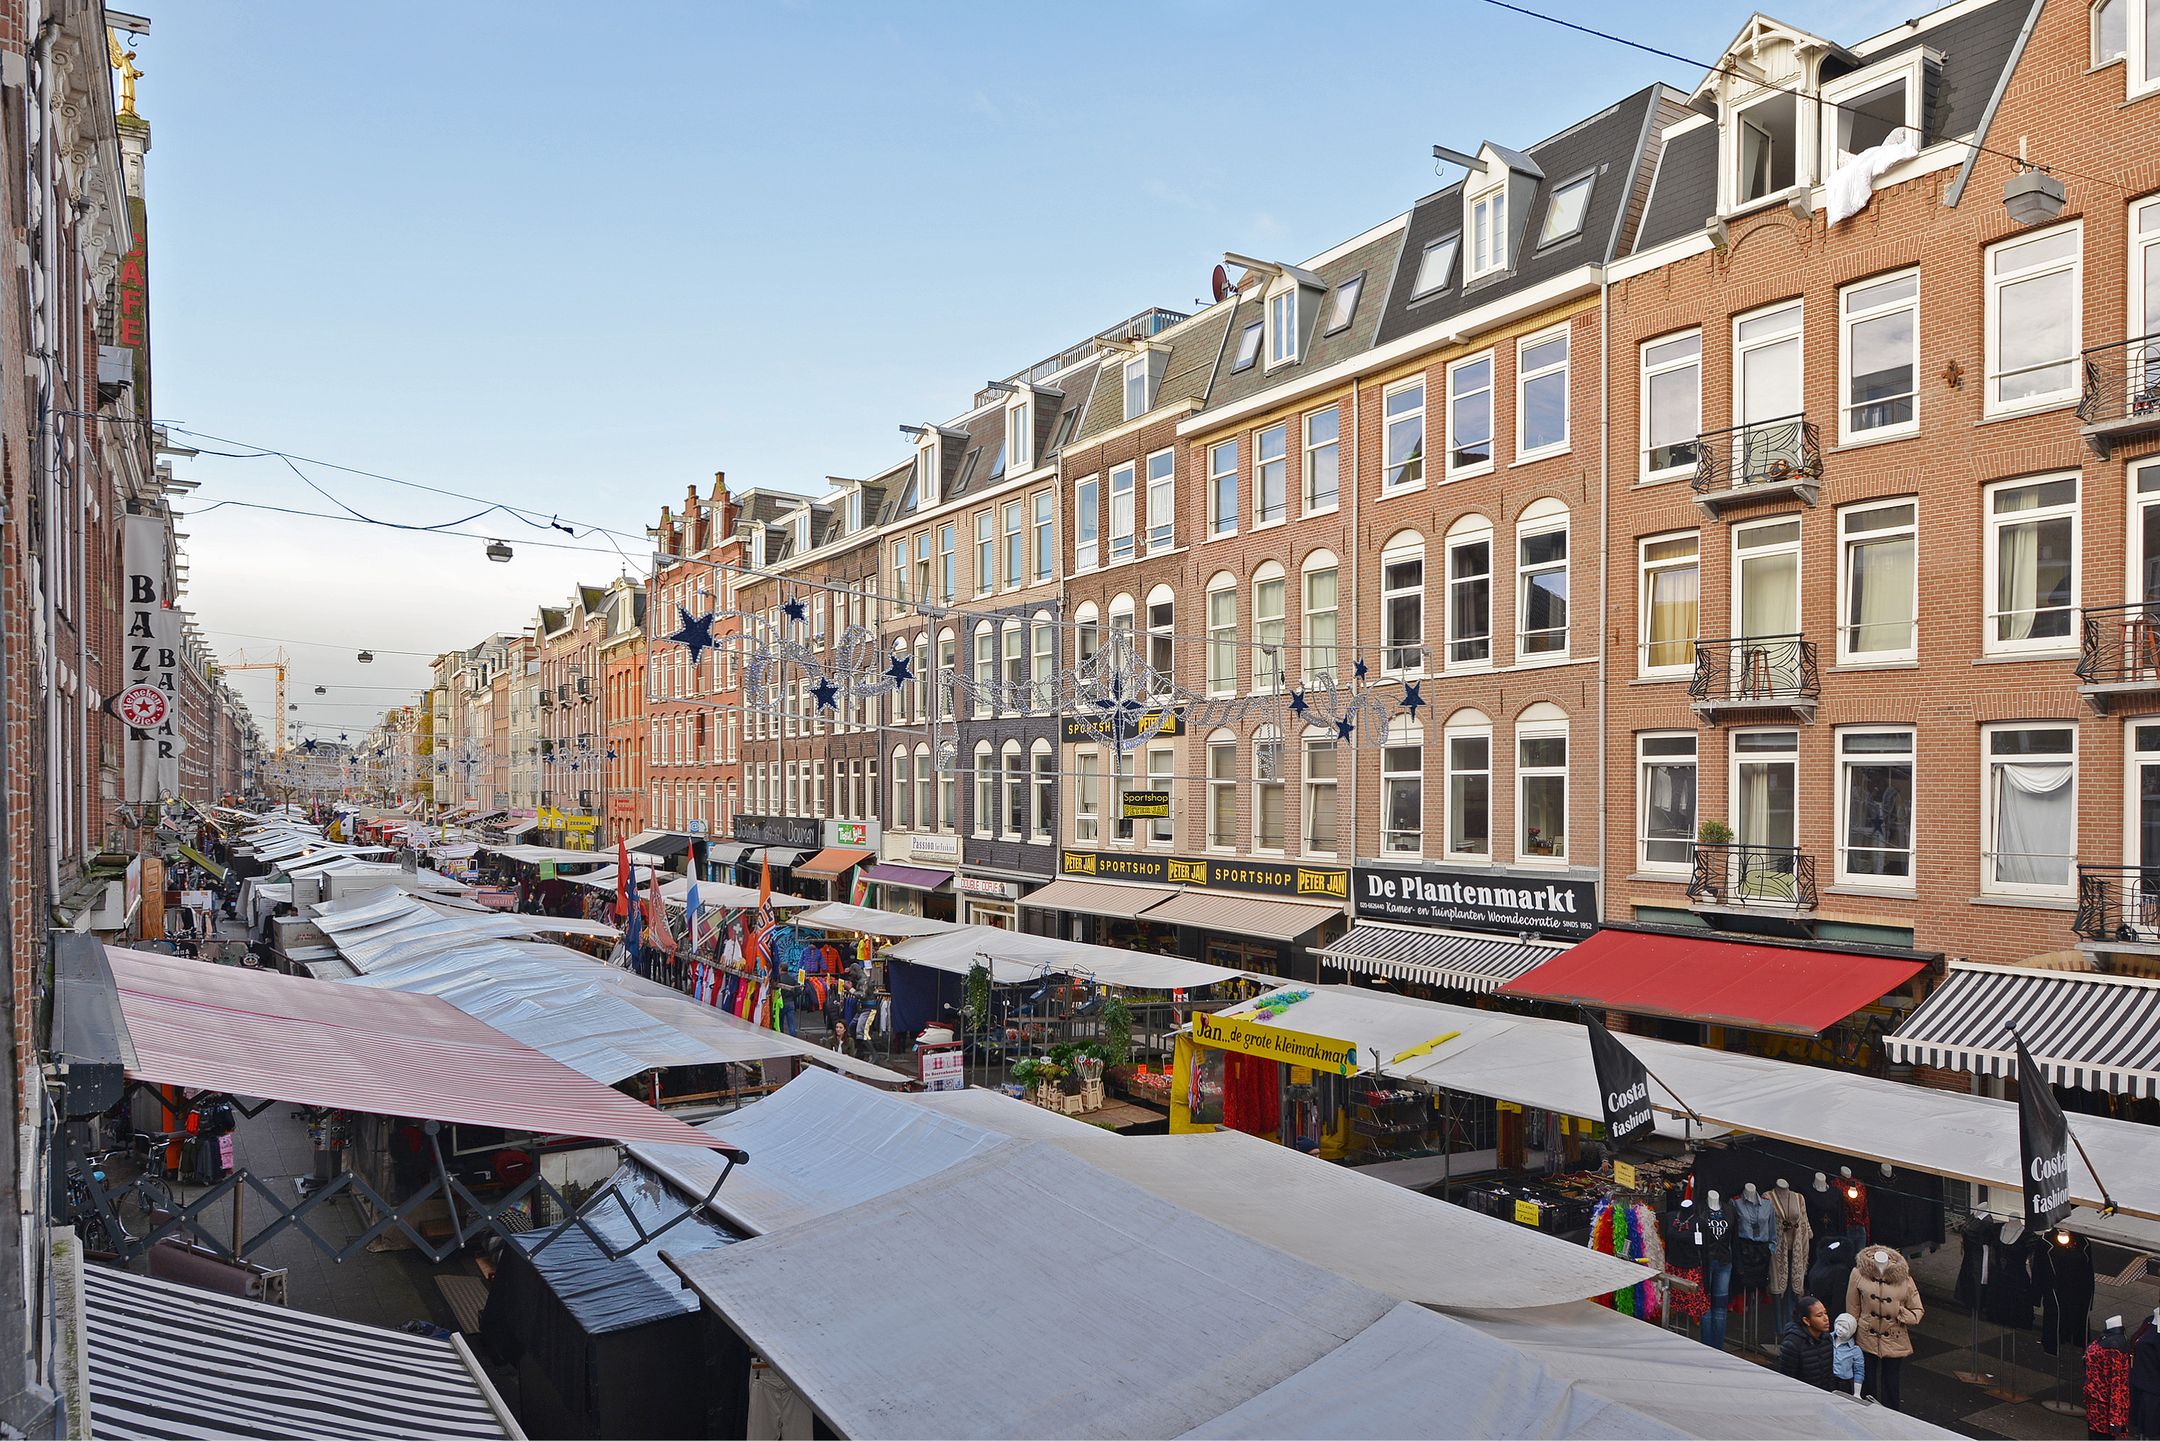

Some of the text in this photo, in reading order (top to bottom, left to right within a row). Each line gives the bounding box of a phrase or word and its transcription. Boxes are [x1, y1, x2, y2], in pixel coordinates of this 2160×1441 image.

[128, 574, 156, 741] BAZ
[123, 689, 164, 712] Heineken's
[158, 648, 177, 759] BAAR
[133, 715, 156, 725] Bier
[1123, 793, 1169, 803] Sportshop
[912, 837, 935, 850] Passion
[1065, 856, 1345, 894] PETER JAN SPORTSHOP PETER JAN SPORTSHOP PETER JAN
[1367, 874, 1577, 914] De Plantenmarkt
[1386, 902, 1415, 914] Kamer-
[1418, 907, 1430, 916] en
[1431, 905, 1486, 921] Tuinplanten
[1488, 910, 1561, 928] Woondecoratie
[1562, 920, 1579, 929] SINDS
[1580, 921, 1592, 930] 1952
[1244, 1033, 1272, 1049] grote
[1275, 1035, 1348, 1065] kleinvakman
[1608, 1082, 1647, 1113] Costa
[1612, 1108, 1651, 1138] fashion
[2030, 1150, 2068, 1182] Costa
